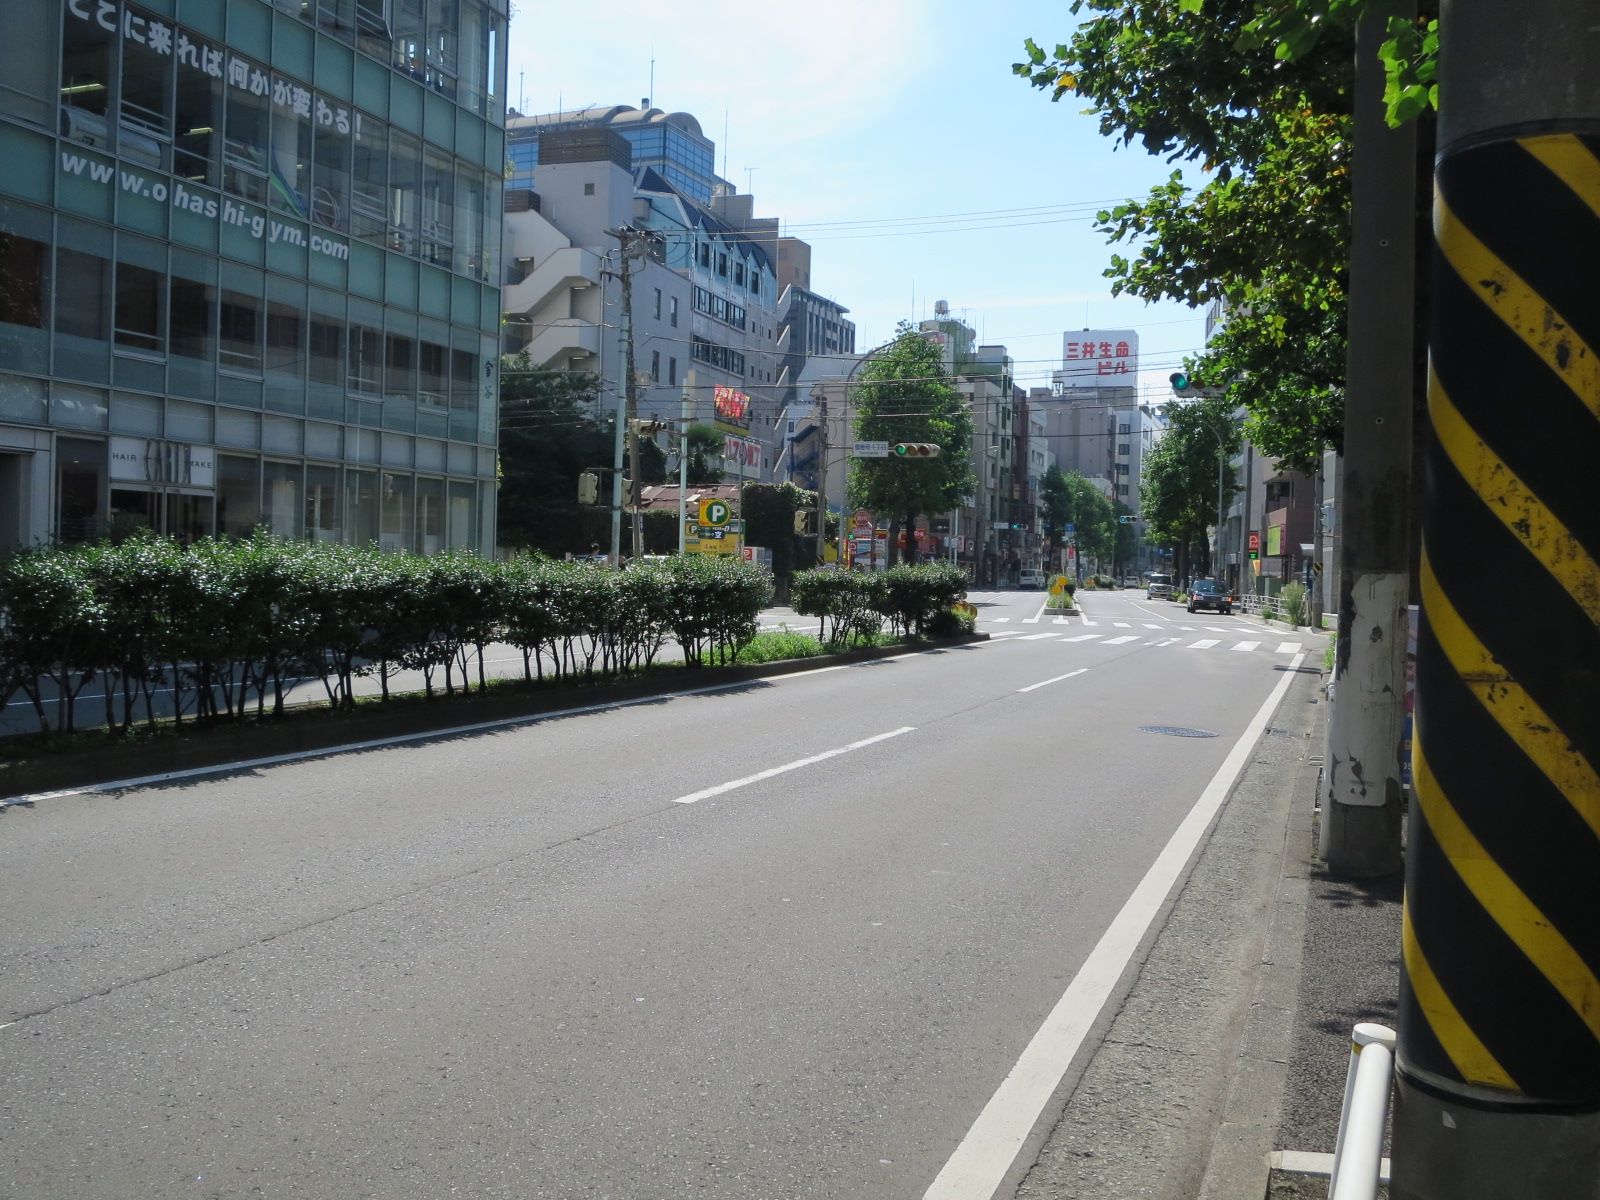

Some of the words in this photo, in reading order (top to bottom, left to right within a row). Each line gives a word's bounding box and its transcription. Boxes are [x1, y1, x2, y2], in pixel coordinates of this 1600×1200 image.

[1066, 341, 1129, 359] 三井生命
[1097, 360, 1129, 375] ビル
[112, 452, 137, 462] HAIR
[711, 504, 725, 522] P
